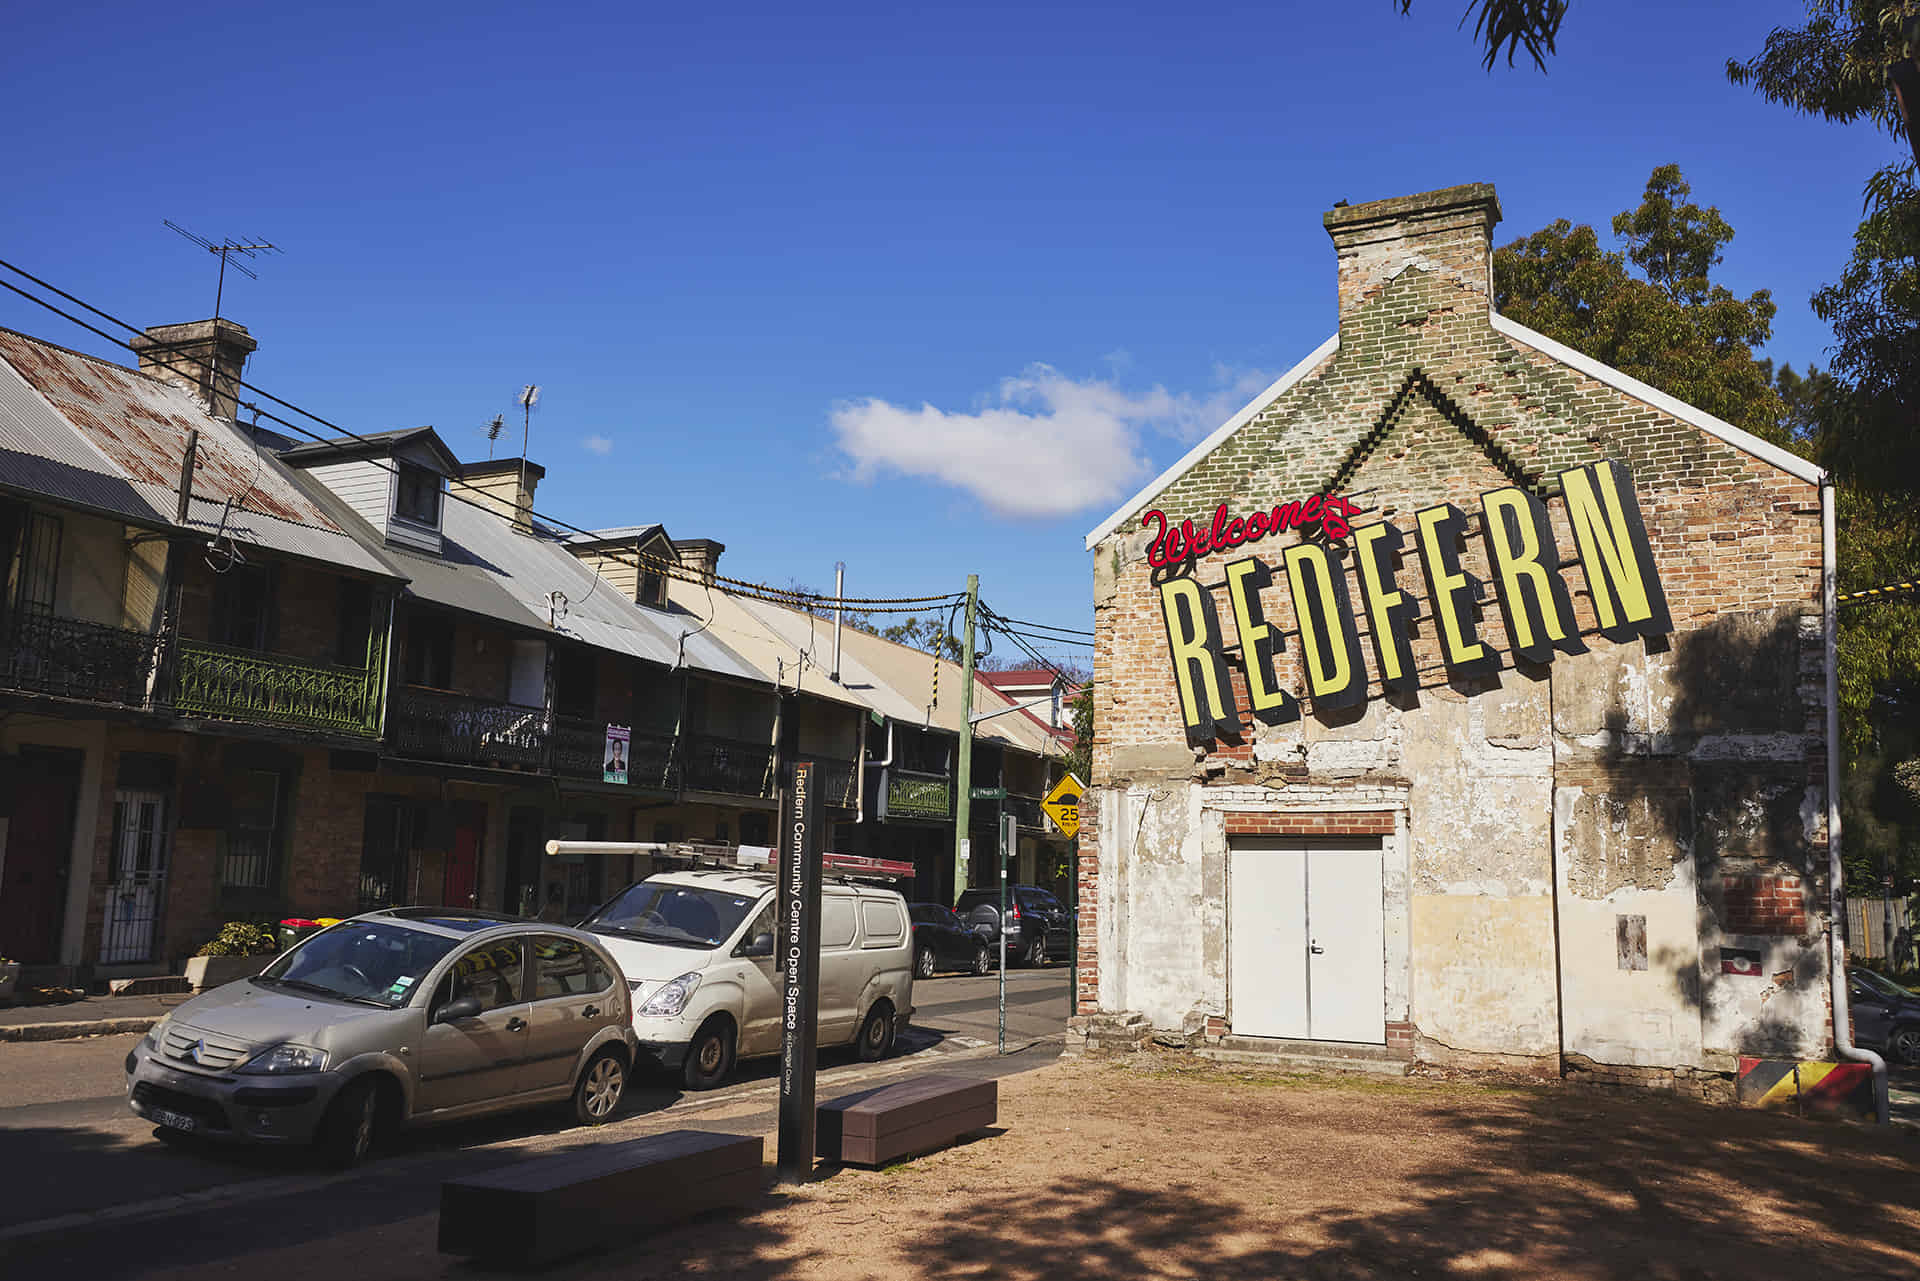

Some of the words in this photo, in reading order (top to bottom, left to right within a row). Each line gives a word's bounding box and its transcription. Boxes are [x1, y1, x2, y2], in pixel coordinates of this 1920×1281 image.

[1142, 495, 1326, 568] Welcome
[1160, 460, 1662, 730] REDFERN
[795, 769, 807, 818] Redfern
[1060, 808, 1079, 821] 25
[790, 822, 805, 896] Community
[788, 900, 802, 943] Centre
[787, 948, 801, 984] Open
[785, 987, 799, 1030] Space
